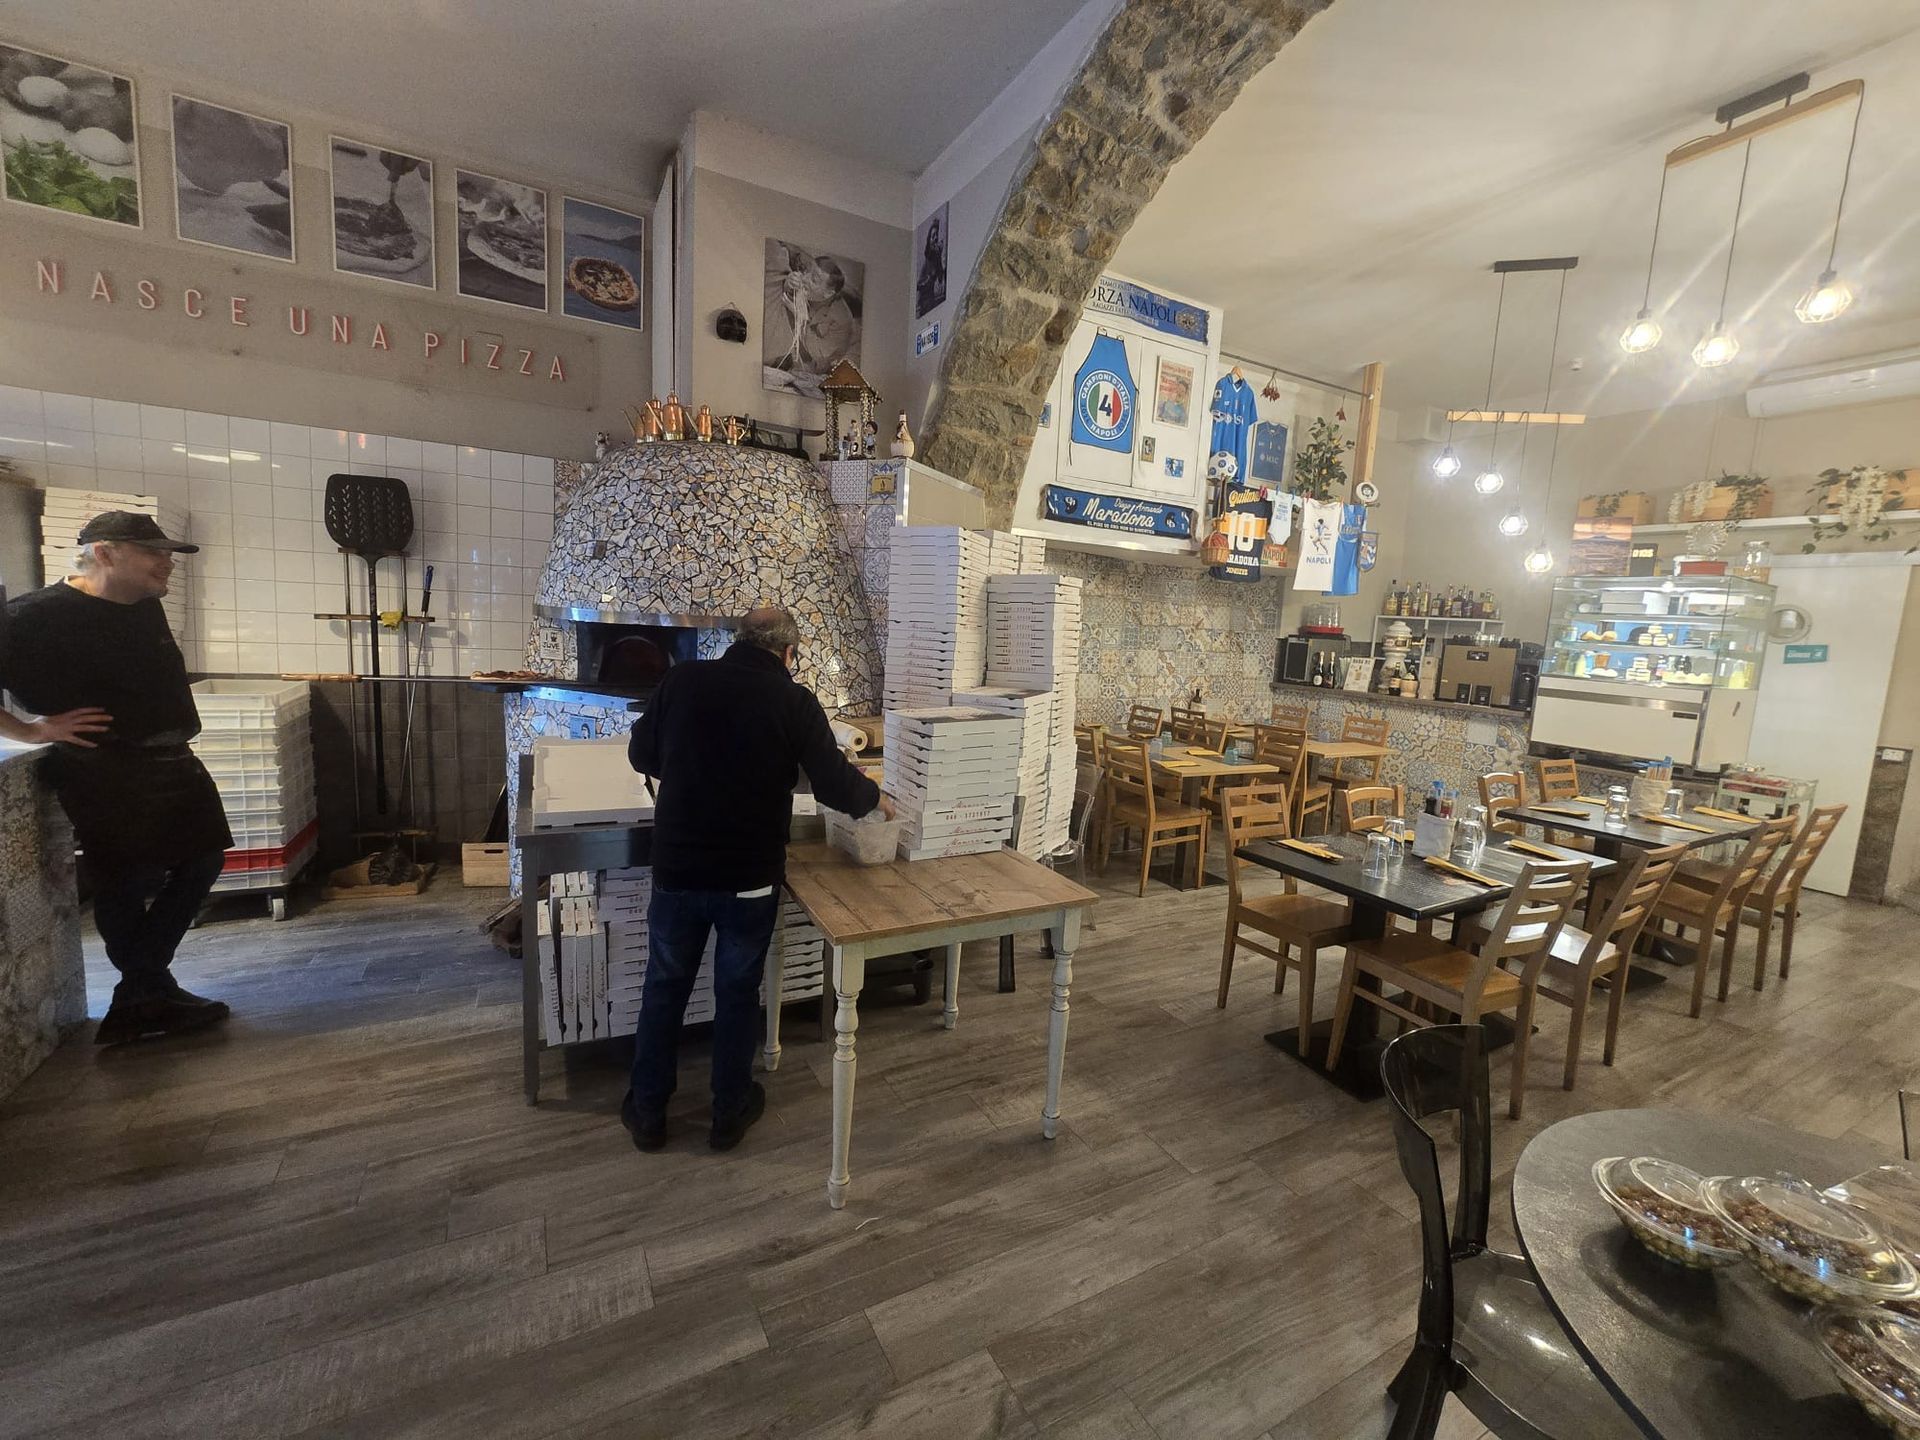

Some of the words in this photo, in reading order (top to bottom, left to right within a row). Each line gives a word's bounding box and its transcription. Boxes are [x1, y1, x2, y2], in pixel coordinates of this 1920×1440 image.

[36, 260, 250, 327] NASCE
[288, 306, 390, 351] UNA
[424, 332, 566, 382] PIZZA
[1128, 294, 1177, 325] NAPOLI
[1081, 373, 1112, 399] CAMPIONI
[1112, 377, 1130, 410] D'ITALIA
[1098, 394, 1112, 417] 4
[1090, 424, 1118, 437] NAPOLI
[1082, 497, 1156, 528] Maradona
[1227, 511, 1256, 552] 10
[1306, 556, 1331, 565] NAPOLI
